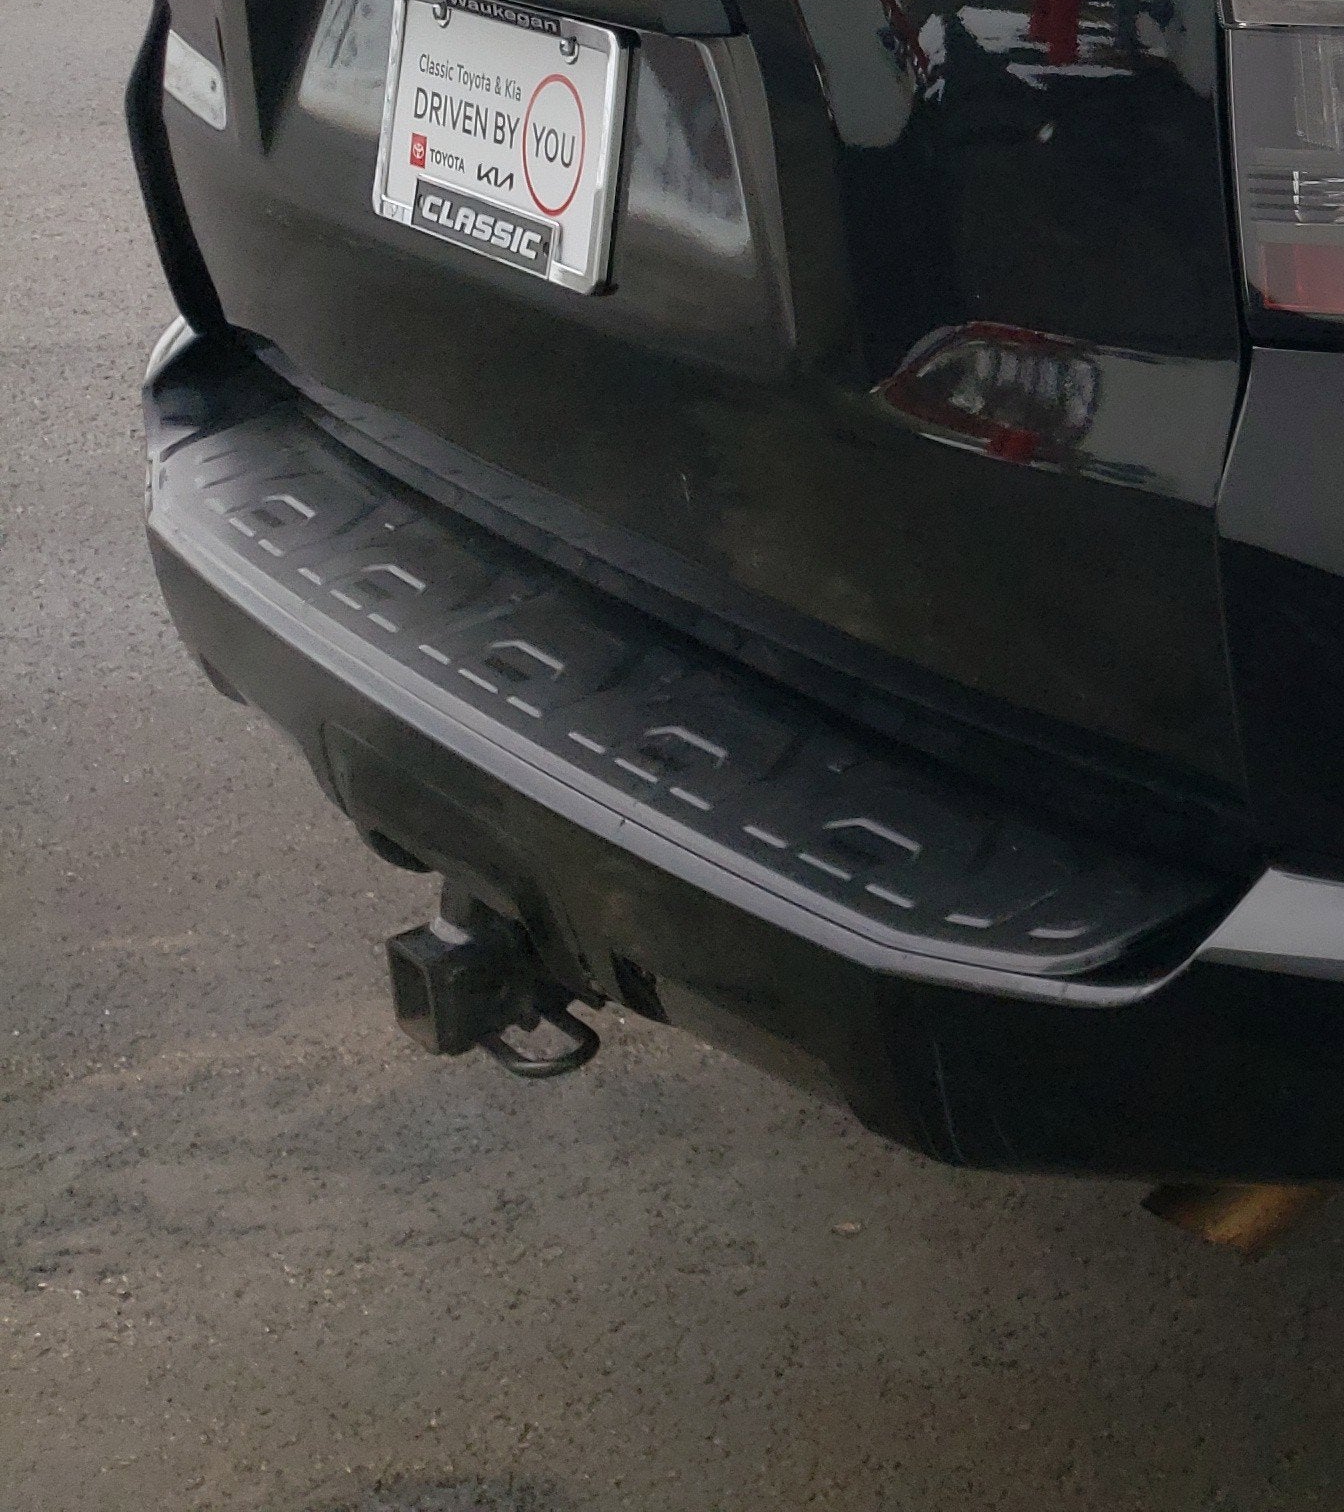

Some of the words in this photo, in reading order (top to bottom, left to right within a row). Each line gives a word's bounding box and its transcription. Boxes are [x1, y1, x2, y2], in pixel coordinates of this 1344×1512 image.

[419, 54, 454, 81] Classic
[457, 64, 491, 93] Toyota
[495, 78, 502, 96] &
[505, 79, 521, 101] Kia
[414, 87, 488, 140] DRIVEN
[495, 112, 520, 150] BY
[532, 122, 576, 169] YOU
[430, 148, 465, 172] TOYOTA
[477, 163, 514, 190] KIA
[421, 194, 542, 260] CLASSIC
